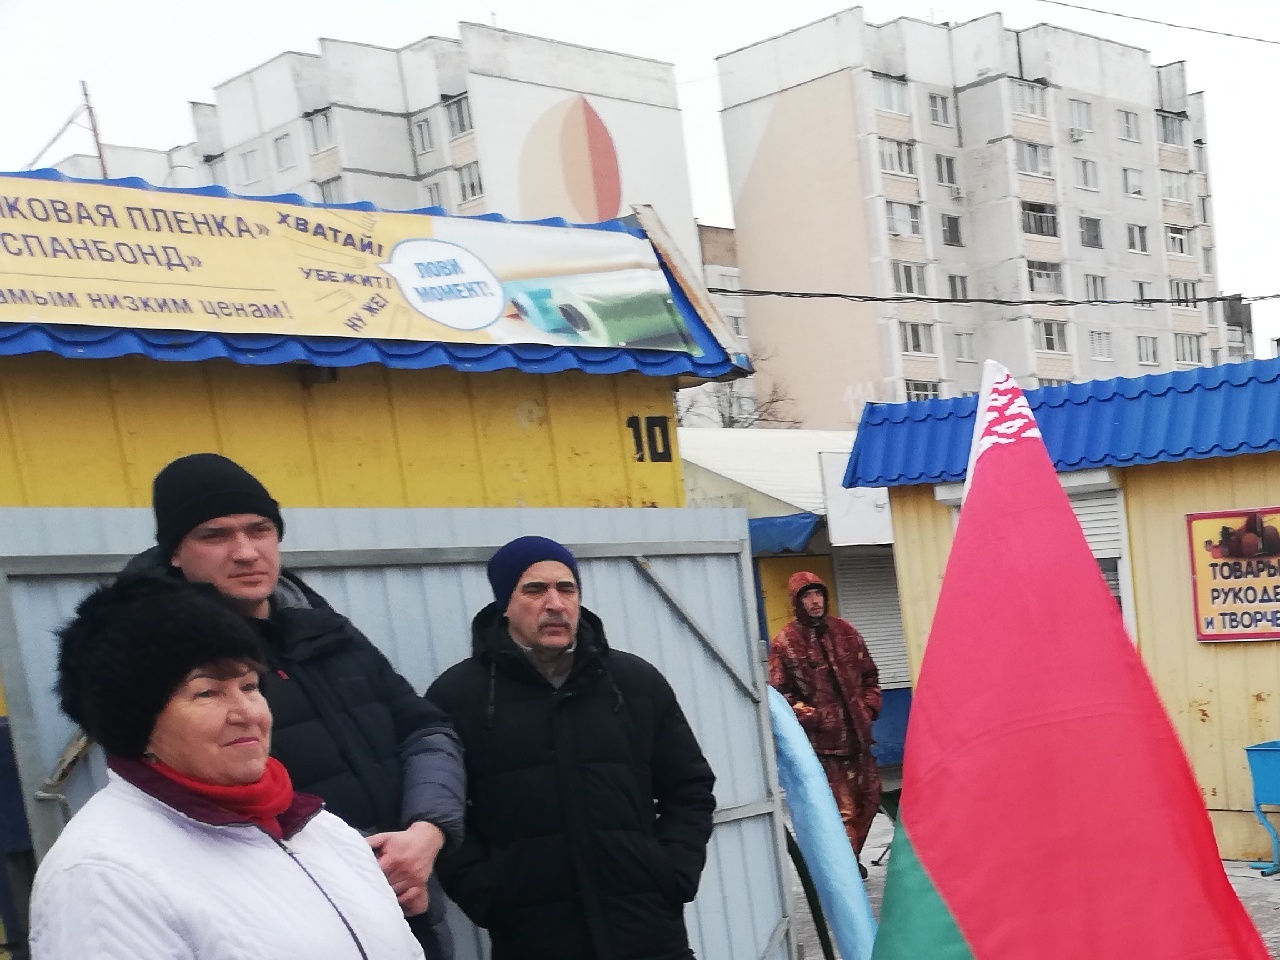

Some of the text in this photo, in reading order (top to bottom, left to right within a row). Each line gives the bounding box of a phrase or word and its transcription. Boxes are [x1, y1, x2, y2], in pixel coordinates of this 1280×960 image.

[125, 206, 271, 239] ПЛЕНКА»
[276, 210, 385, 258] ХВАТАЙ!
[0, 232, 203, 272] СПАНБОНД»
[414, 258, 465, 279] ЛОВИ
[297, 266, 393, 290] УБЕЖИТ!
[413, 280, 495, 304] МОМЕНТ!
[87, 292, 194, 315] низким
[200, 299, 294, 320] ценам!
[344, 292, 391, 333] НУ ЖЕ!
[626, 416, 672, 462] 10
